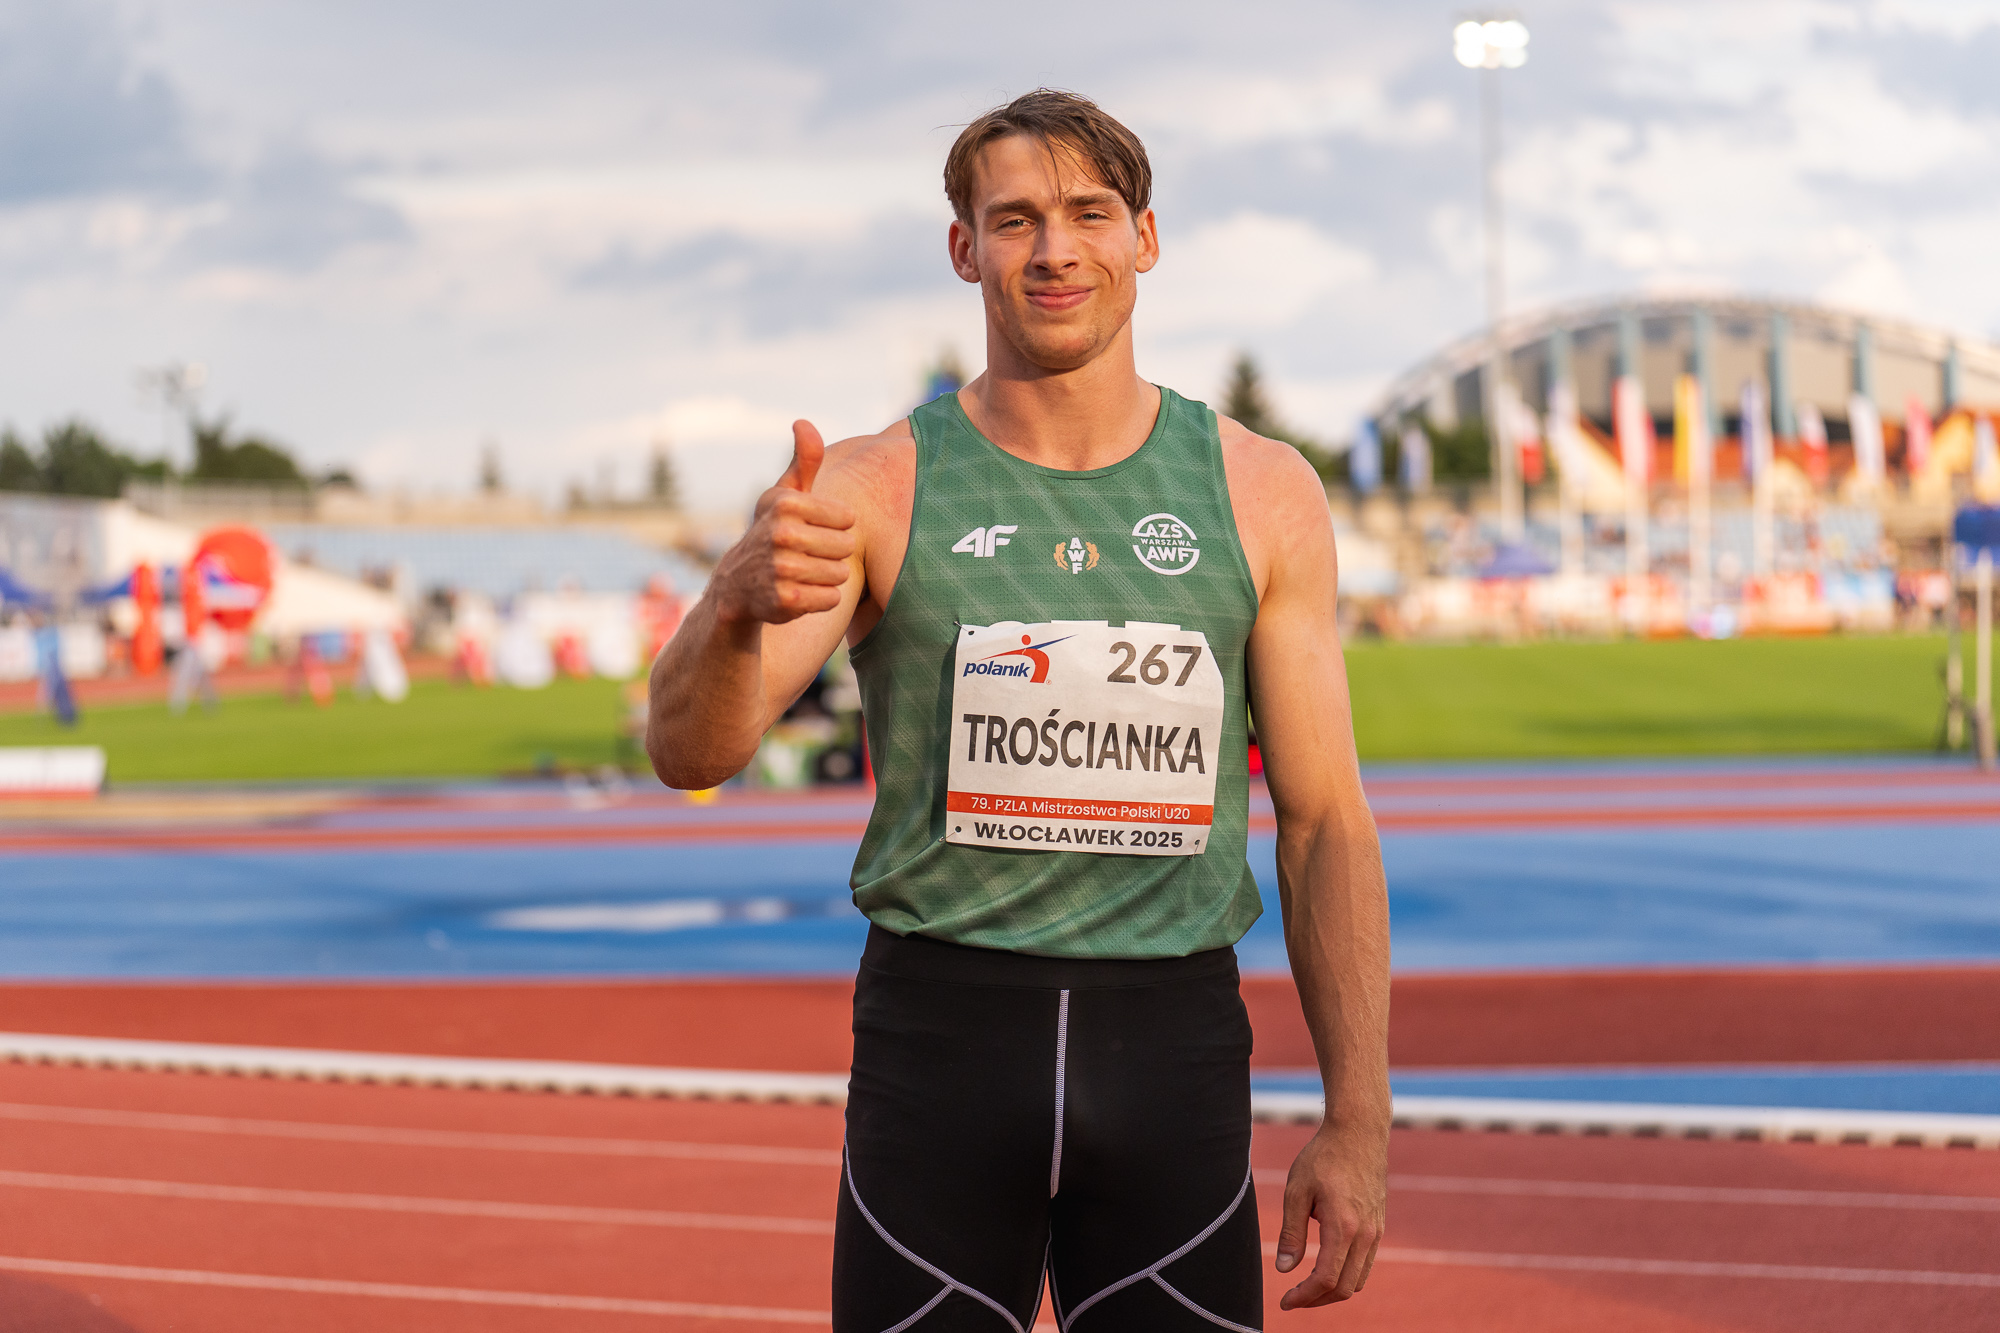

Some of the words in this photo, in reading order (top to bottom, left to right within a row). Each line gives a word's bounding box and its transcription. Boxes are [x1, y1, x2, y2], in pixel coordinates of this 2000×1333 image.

[951, 524, 1018, 558] 4F
[1140, 538, 1192, 547] WARSZAWA
[1145, 523, 1183, 539] AZS
[1146, 546, 1190, 562] AWF
[963, 660, 1031, 678] polanik
[1107, 641, 1202, 687] 267
[962, 708, 1206, 775] TROŚCIANKA
[971, 796, 991, 810] 79.
[995, 799, 1028, 812] PZLA
[1032, 801, 1117, 817] Mistrzostwa
[1120, 805, 1161, 819] Polski
[1164, 808, 1190, 820] U20
[974, 821, 1125, 846] WŁOCŁAWEK
[1130, 830, 1183, 848] 2025
